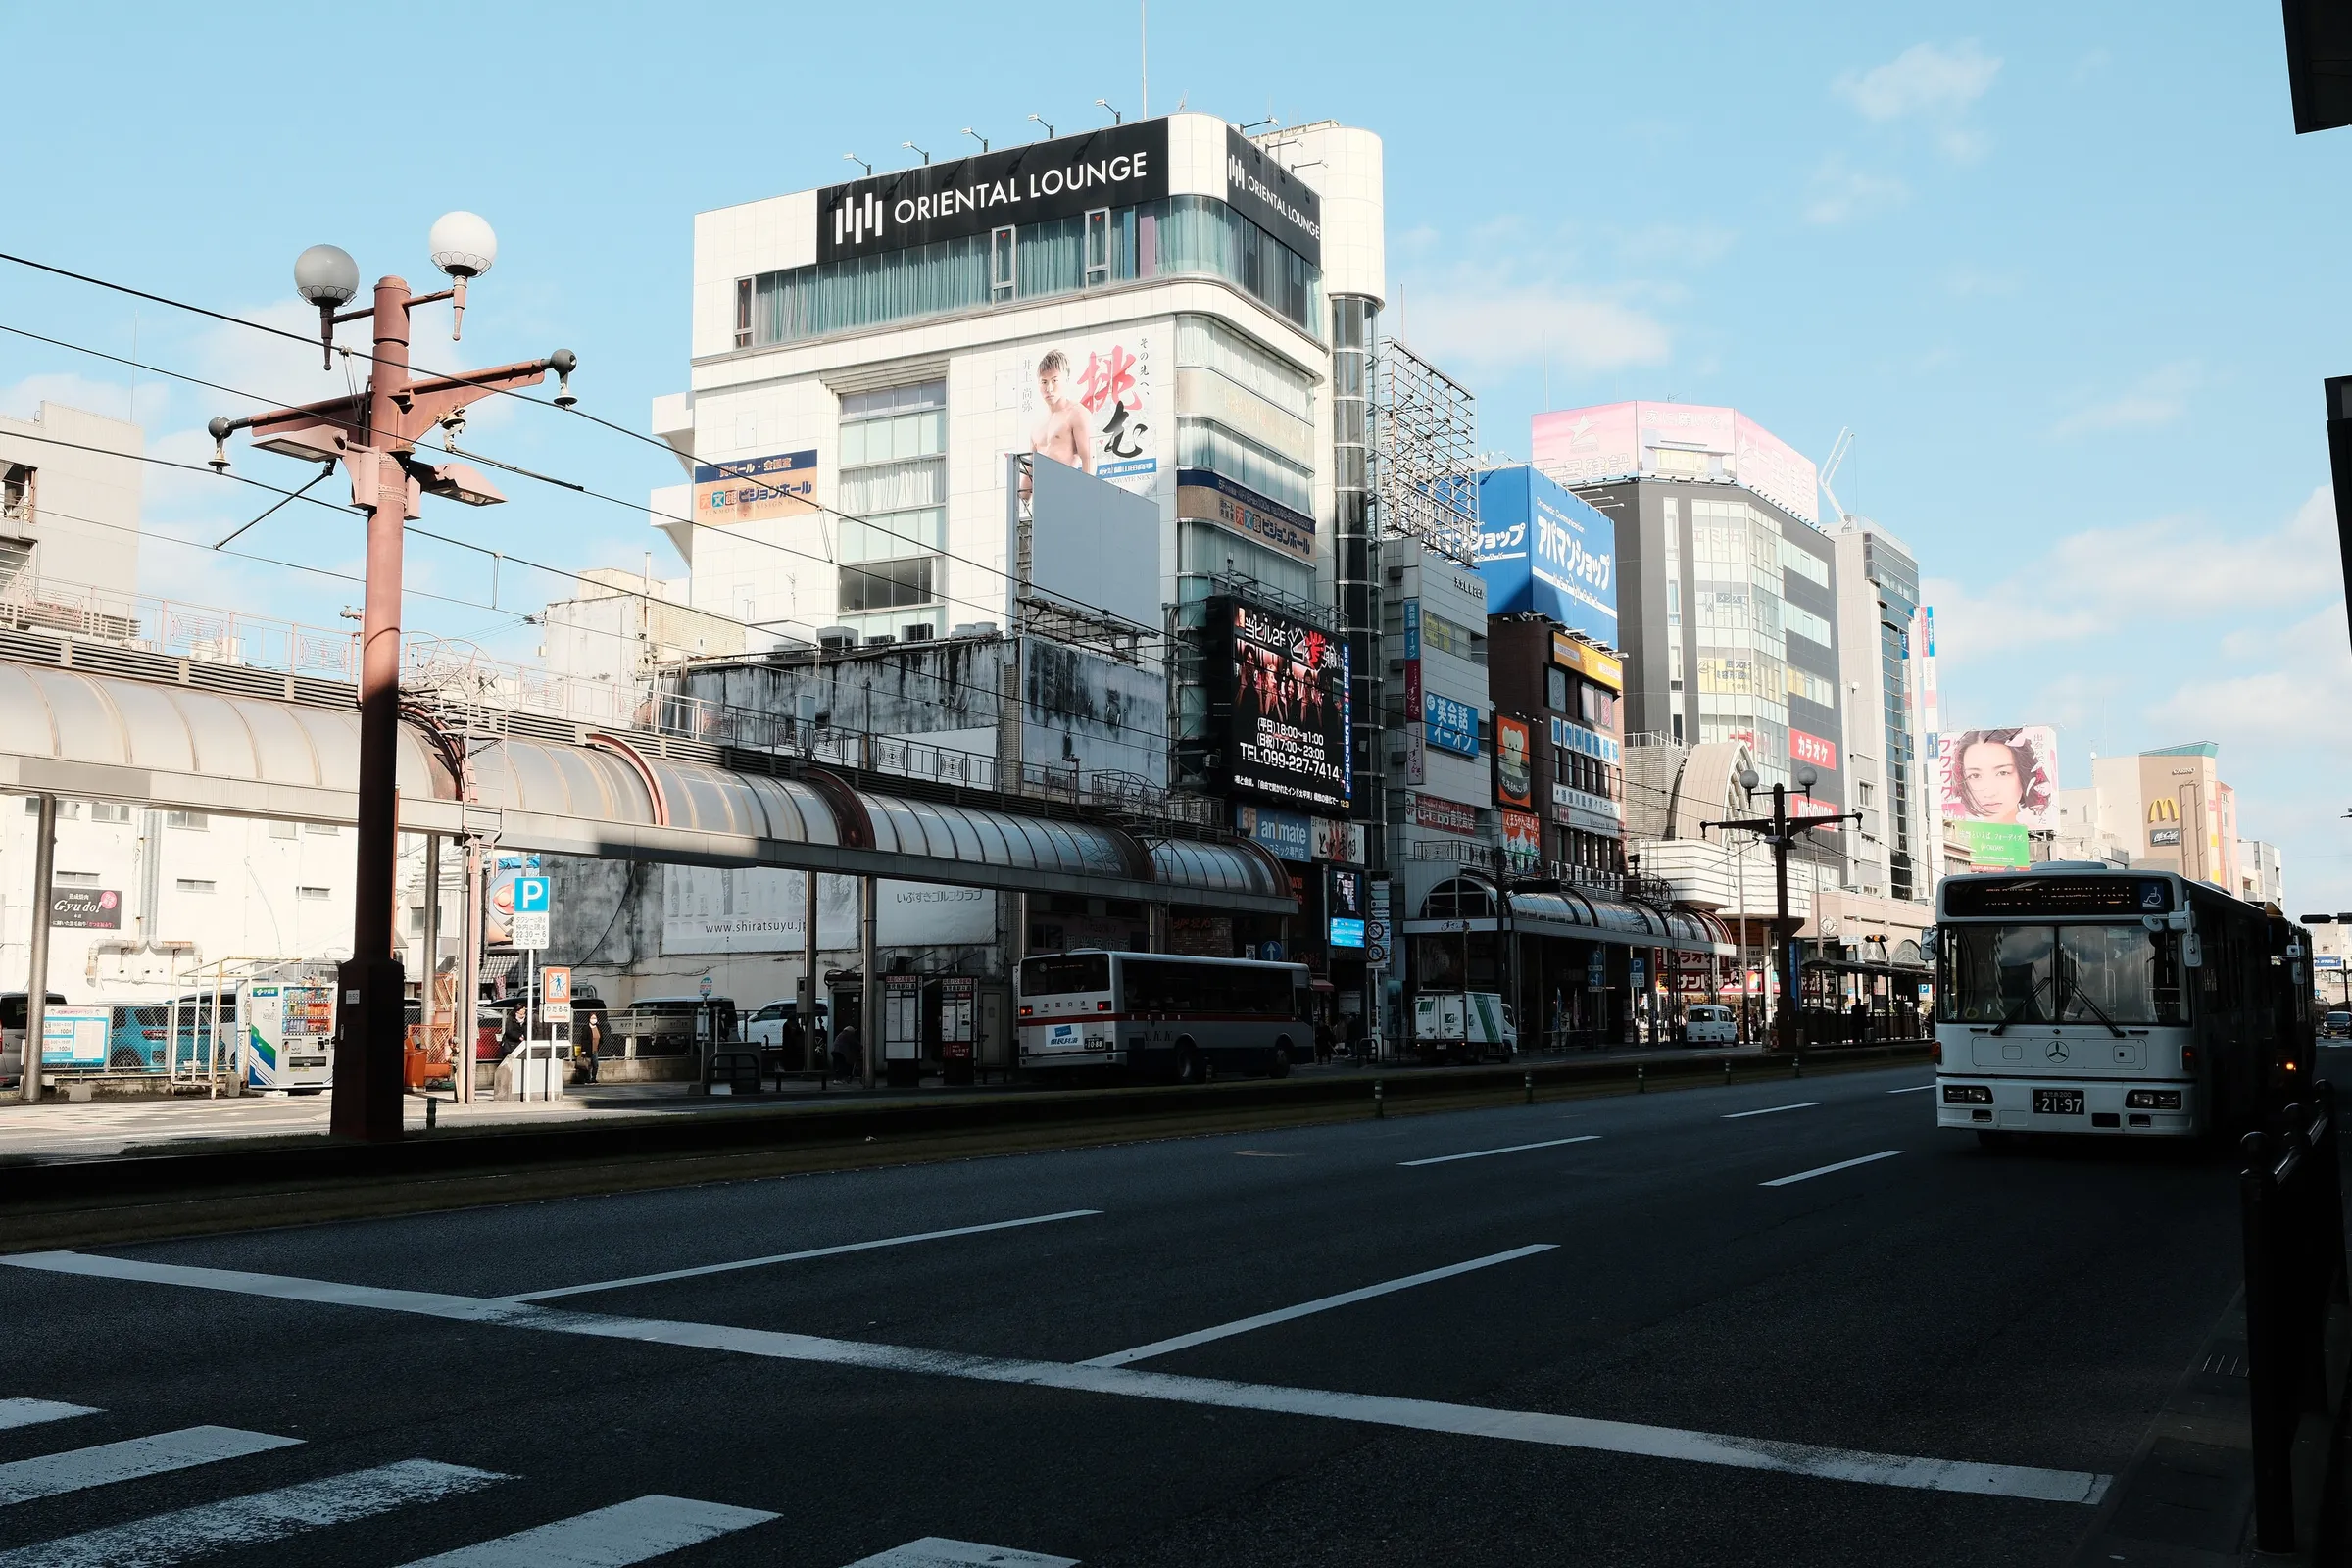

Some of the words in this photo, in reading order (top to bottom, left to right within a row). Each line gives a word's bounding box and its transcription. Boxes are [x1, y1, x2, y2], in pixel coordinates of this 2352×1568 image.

[894, 177, 1021, 225] ORIENTAL
[1029, 152, 1148, 198] LOUNGE
[1248, 175, 1287, 217] ORIENTAL
[1288, 205, 1320, 240] LOUNGE
[1537, 514, 1611, 591] アパマンショップ
[1408, 630, 1417, 659] イーオン
[1437, 697, 1468, 731] 英会話
[1434, 723, 1472, 751] イーオン
[1797, 735, 1828, 763] カラオケ
[1240, 742, 1340, 782] TEL:099-227-7414
[1938, 739, 1953, 801] ワクワク
[1261, 813, 1306, 845] animate
[522, 880, 543, 908] P
[1634, 960, 1642, 971] P
[1922, 984, 1928, 993] P
[2042, 1098, 2082, 1112] 21-97
